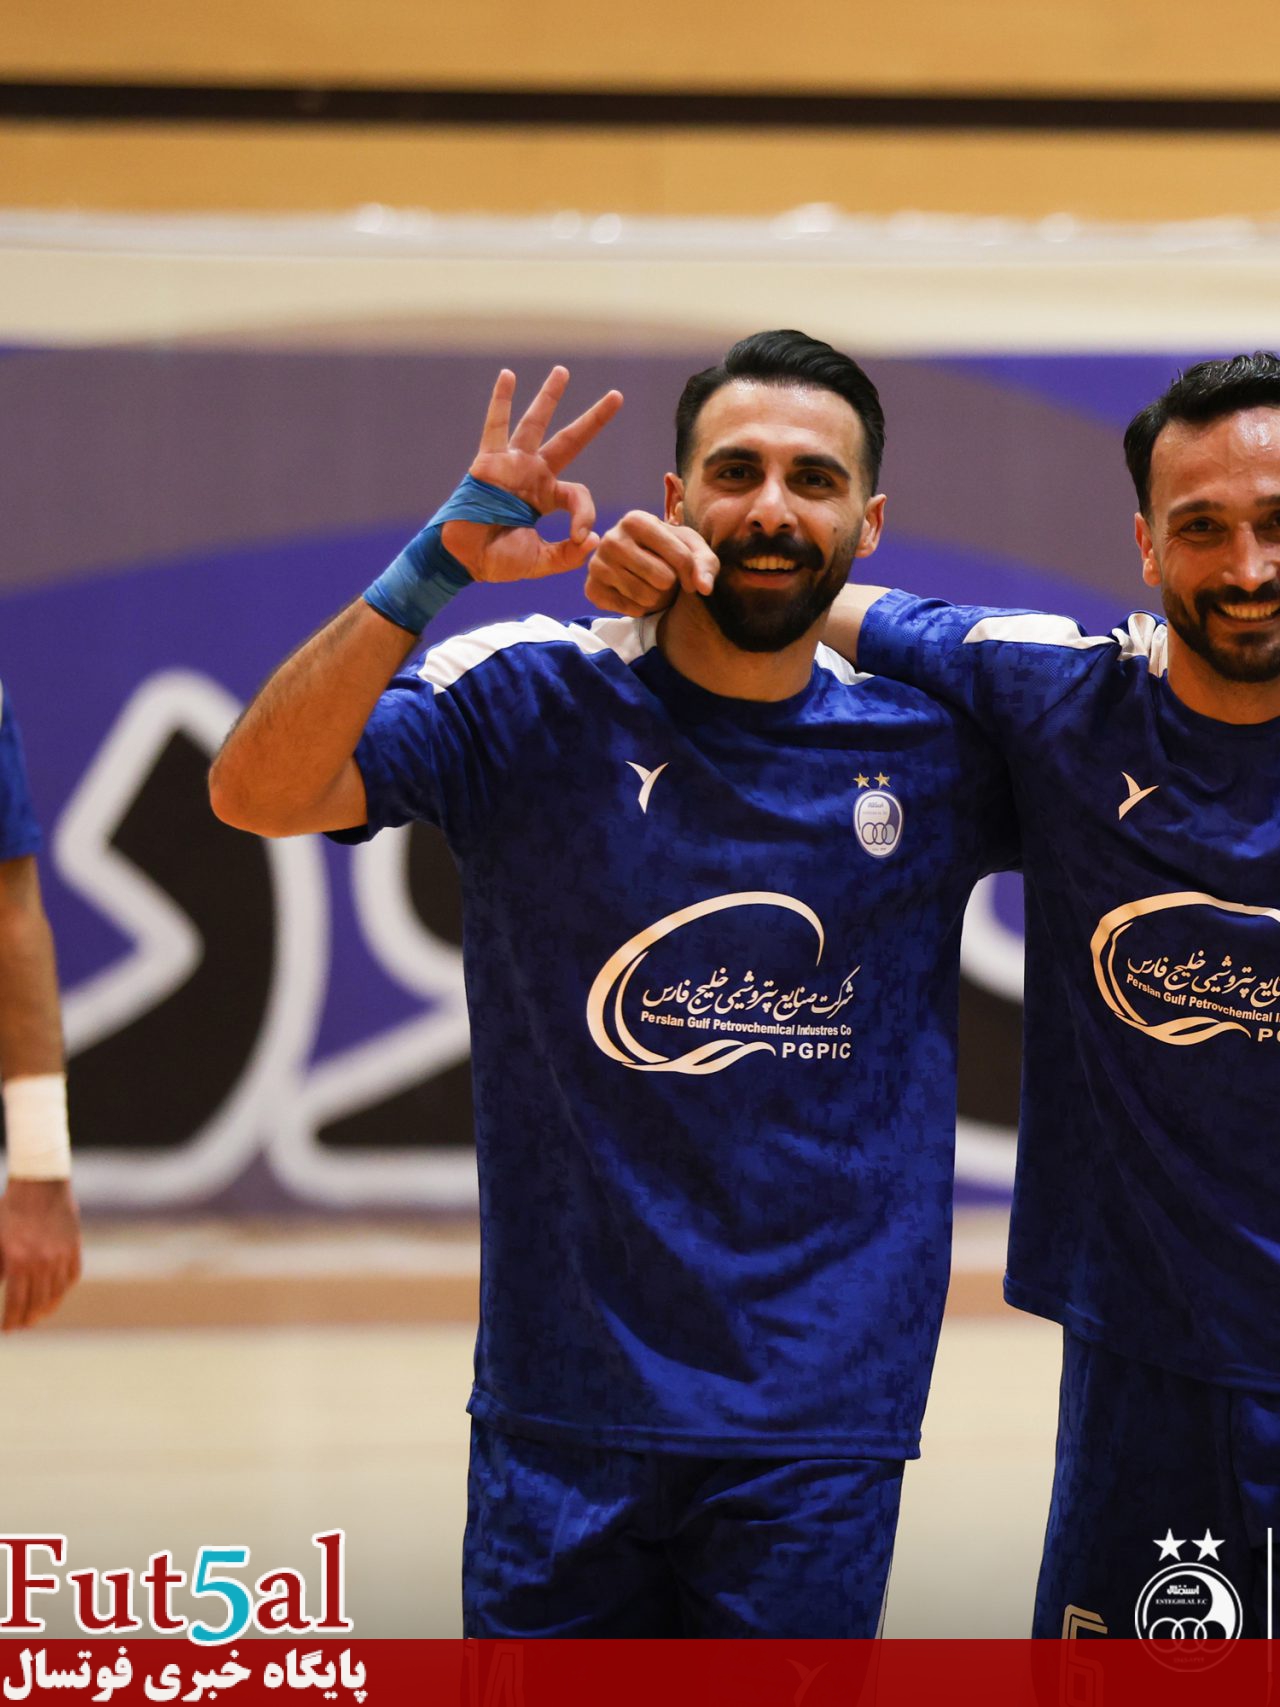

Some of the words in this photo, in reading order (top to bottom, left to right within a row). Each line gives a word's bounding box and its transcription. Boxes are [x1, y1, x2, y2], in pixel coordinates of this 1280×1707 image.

[1127, 956, 1169, 979] فارس
[1163, 950, 1207, 991] خلیج
[642, 978, 691, 1007] فارس
[686, 967, 729, 1015] خلیج
[772, 986, 818, 1022] صنایع
[811, 965, 861, 1019] شرکت
[1126, 973, 1161, 999] Persian
[1163, 991, 1187, 1010] Gulf
[640, 1010, 684, 1027] Persian
[687, 1016, 711, 1029] Gulf
[840, 1024, 853, 1036] Co
[782, 1042, 852, 1059] PGPIC
